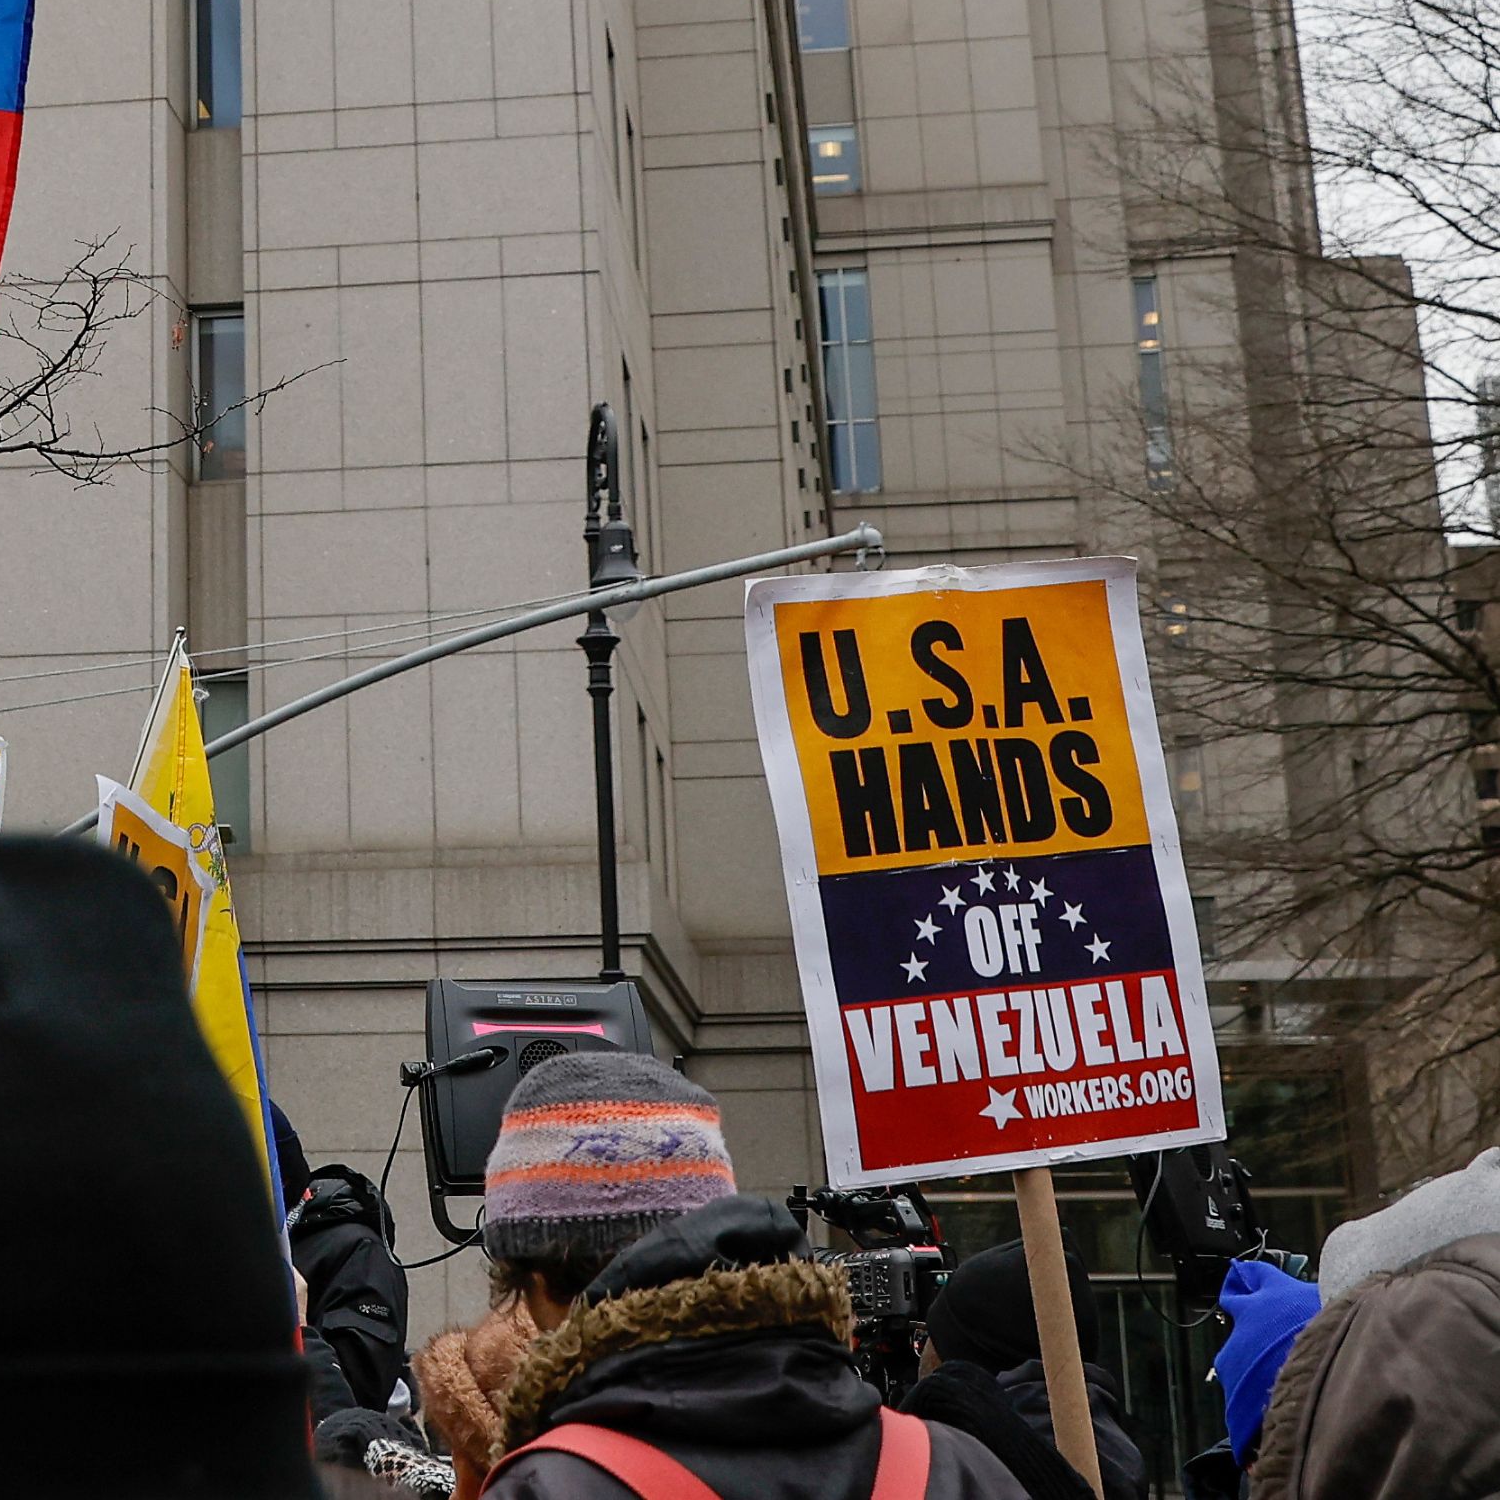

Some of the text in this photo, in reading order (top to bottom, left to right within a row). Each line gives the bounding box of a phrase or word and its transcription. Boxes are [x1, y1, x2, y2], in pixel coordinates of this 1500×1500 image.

[799, 617, 1093, 738] U.S.A.
[829, 730, 1113, 857] HANDS
[963, 902, 1042, 978] OFF
[844, 975, 1186, 1093] VENEZUELA
[1024, 1066, 1192, 1119] WORKERS.ORG
